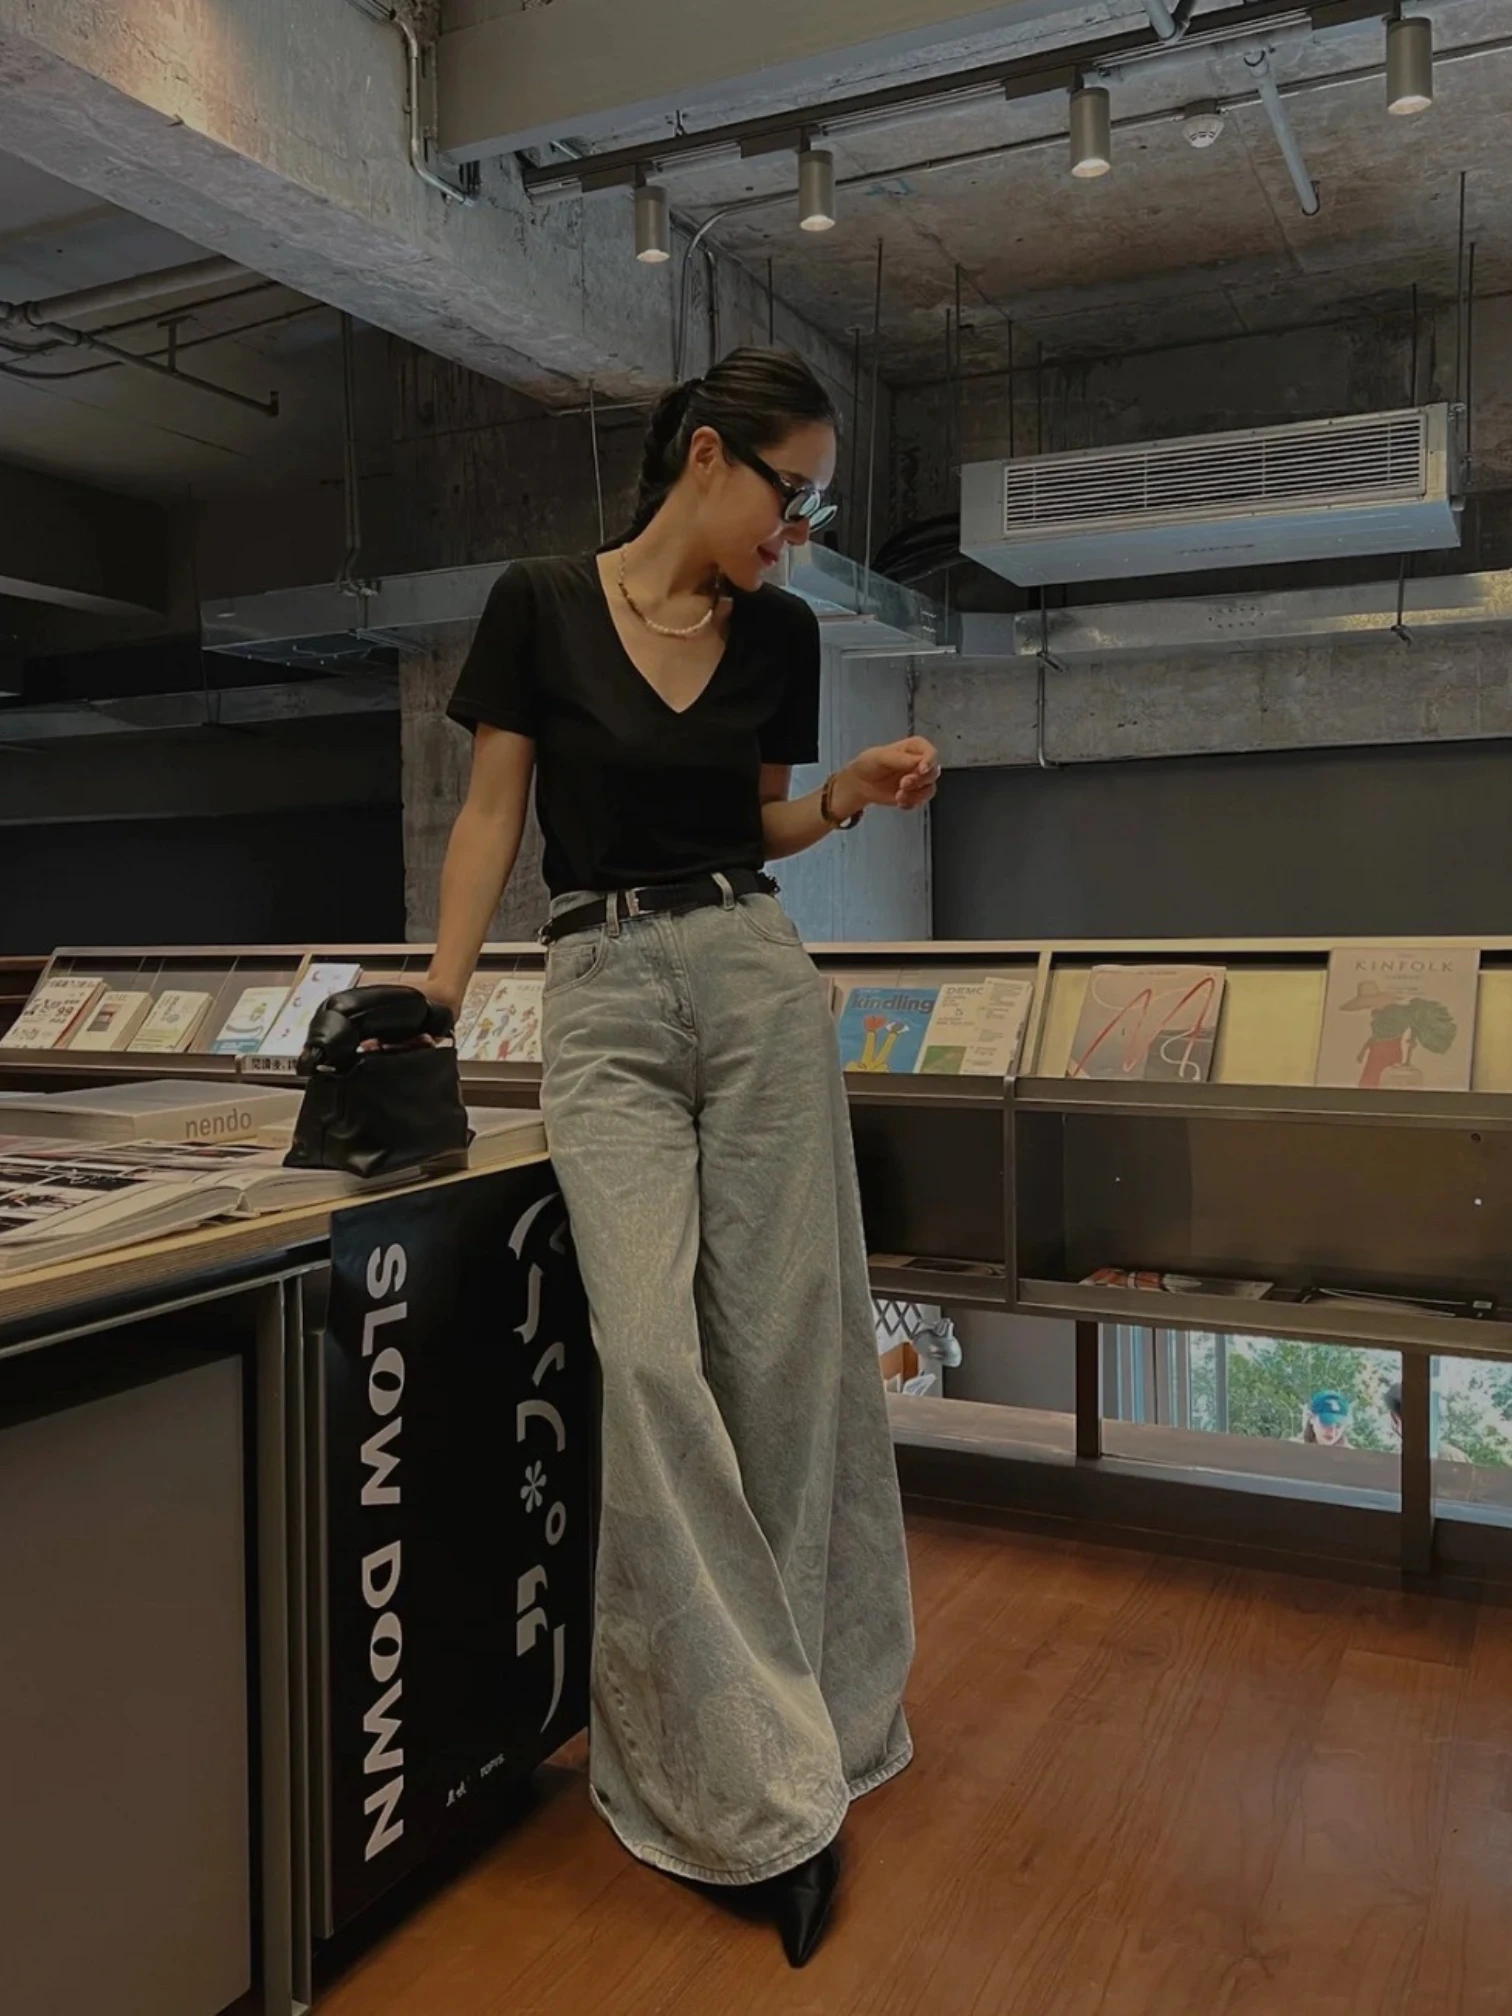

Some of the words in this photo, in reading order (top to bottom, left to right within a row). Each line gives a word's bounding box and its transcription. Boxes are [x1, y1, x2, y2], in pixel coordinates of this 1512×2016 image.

[1355, 960, 1454, 973] KINFOLK
[850, 994, 936, 1015] kindling
[185, 1108, 252, 1139] nendo
[361, 1243, 408, 1506] SLOW
[361, 1540, 405, 1863] DOWN
